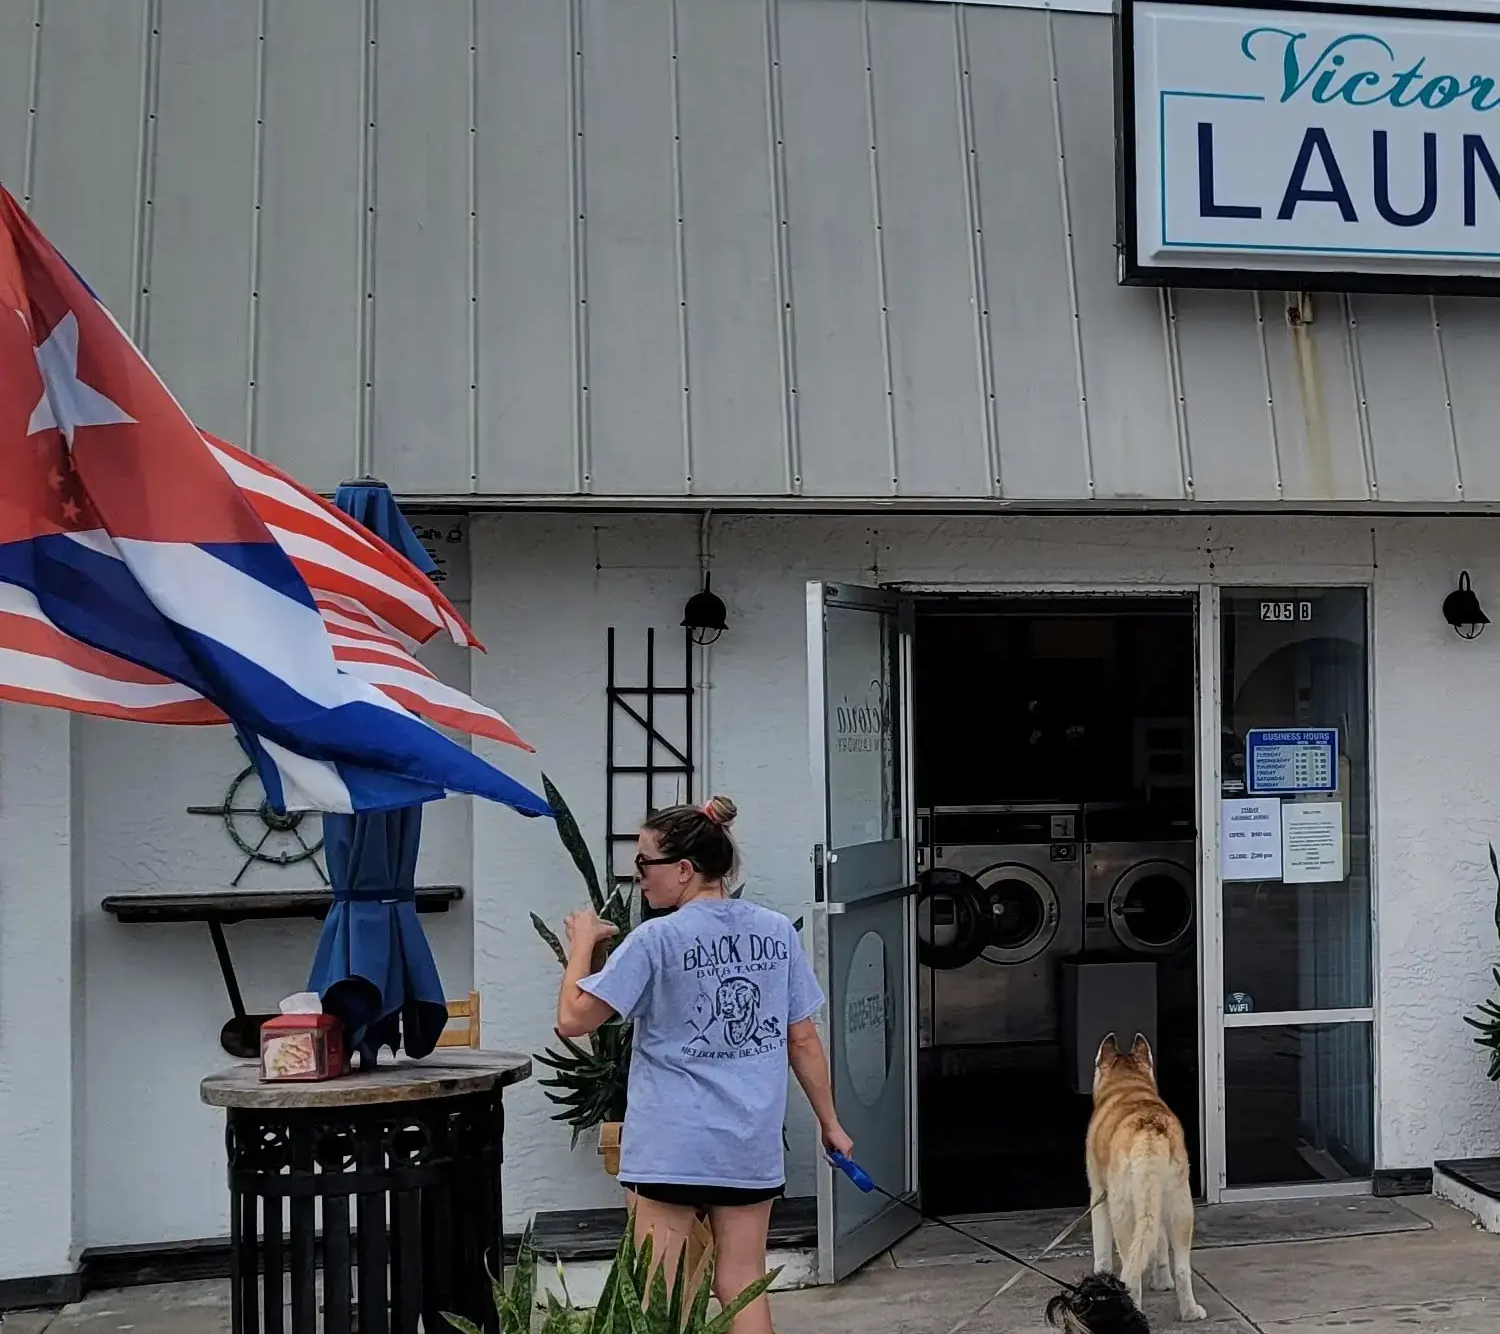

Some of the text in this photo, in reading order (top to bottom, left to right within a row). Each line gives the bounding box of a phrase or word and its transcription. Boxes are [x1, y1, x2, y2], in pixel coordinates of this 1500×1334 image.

[1262, 603, 1310, 619] 205 B
[1262, 732, 1330, 741] BUSINESS HOURS
[683, 933, 788, 971] BLACK DOG
[734, 961, 778, 974] TACKLE
